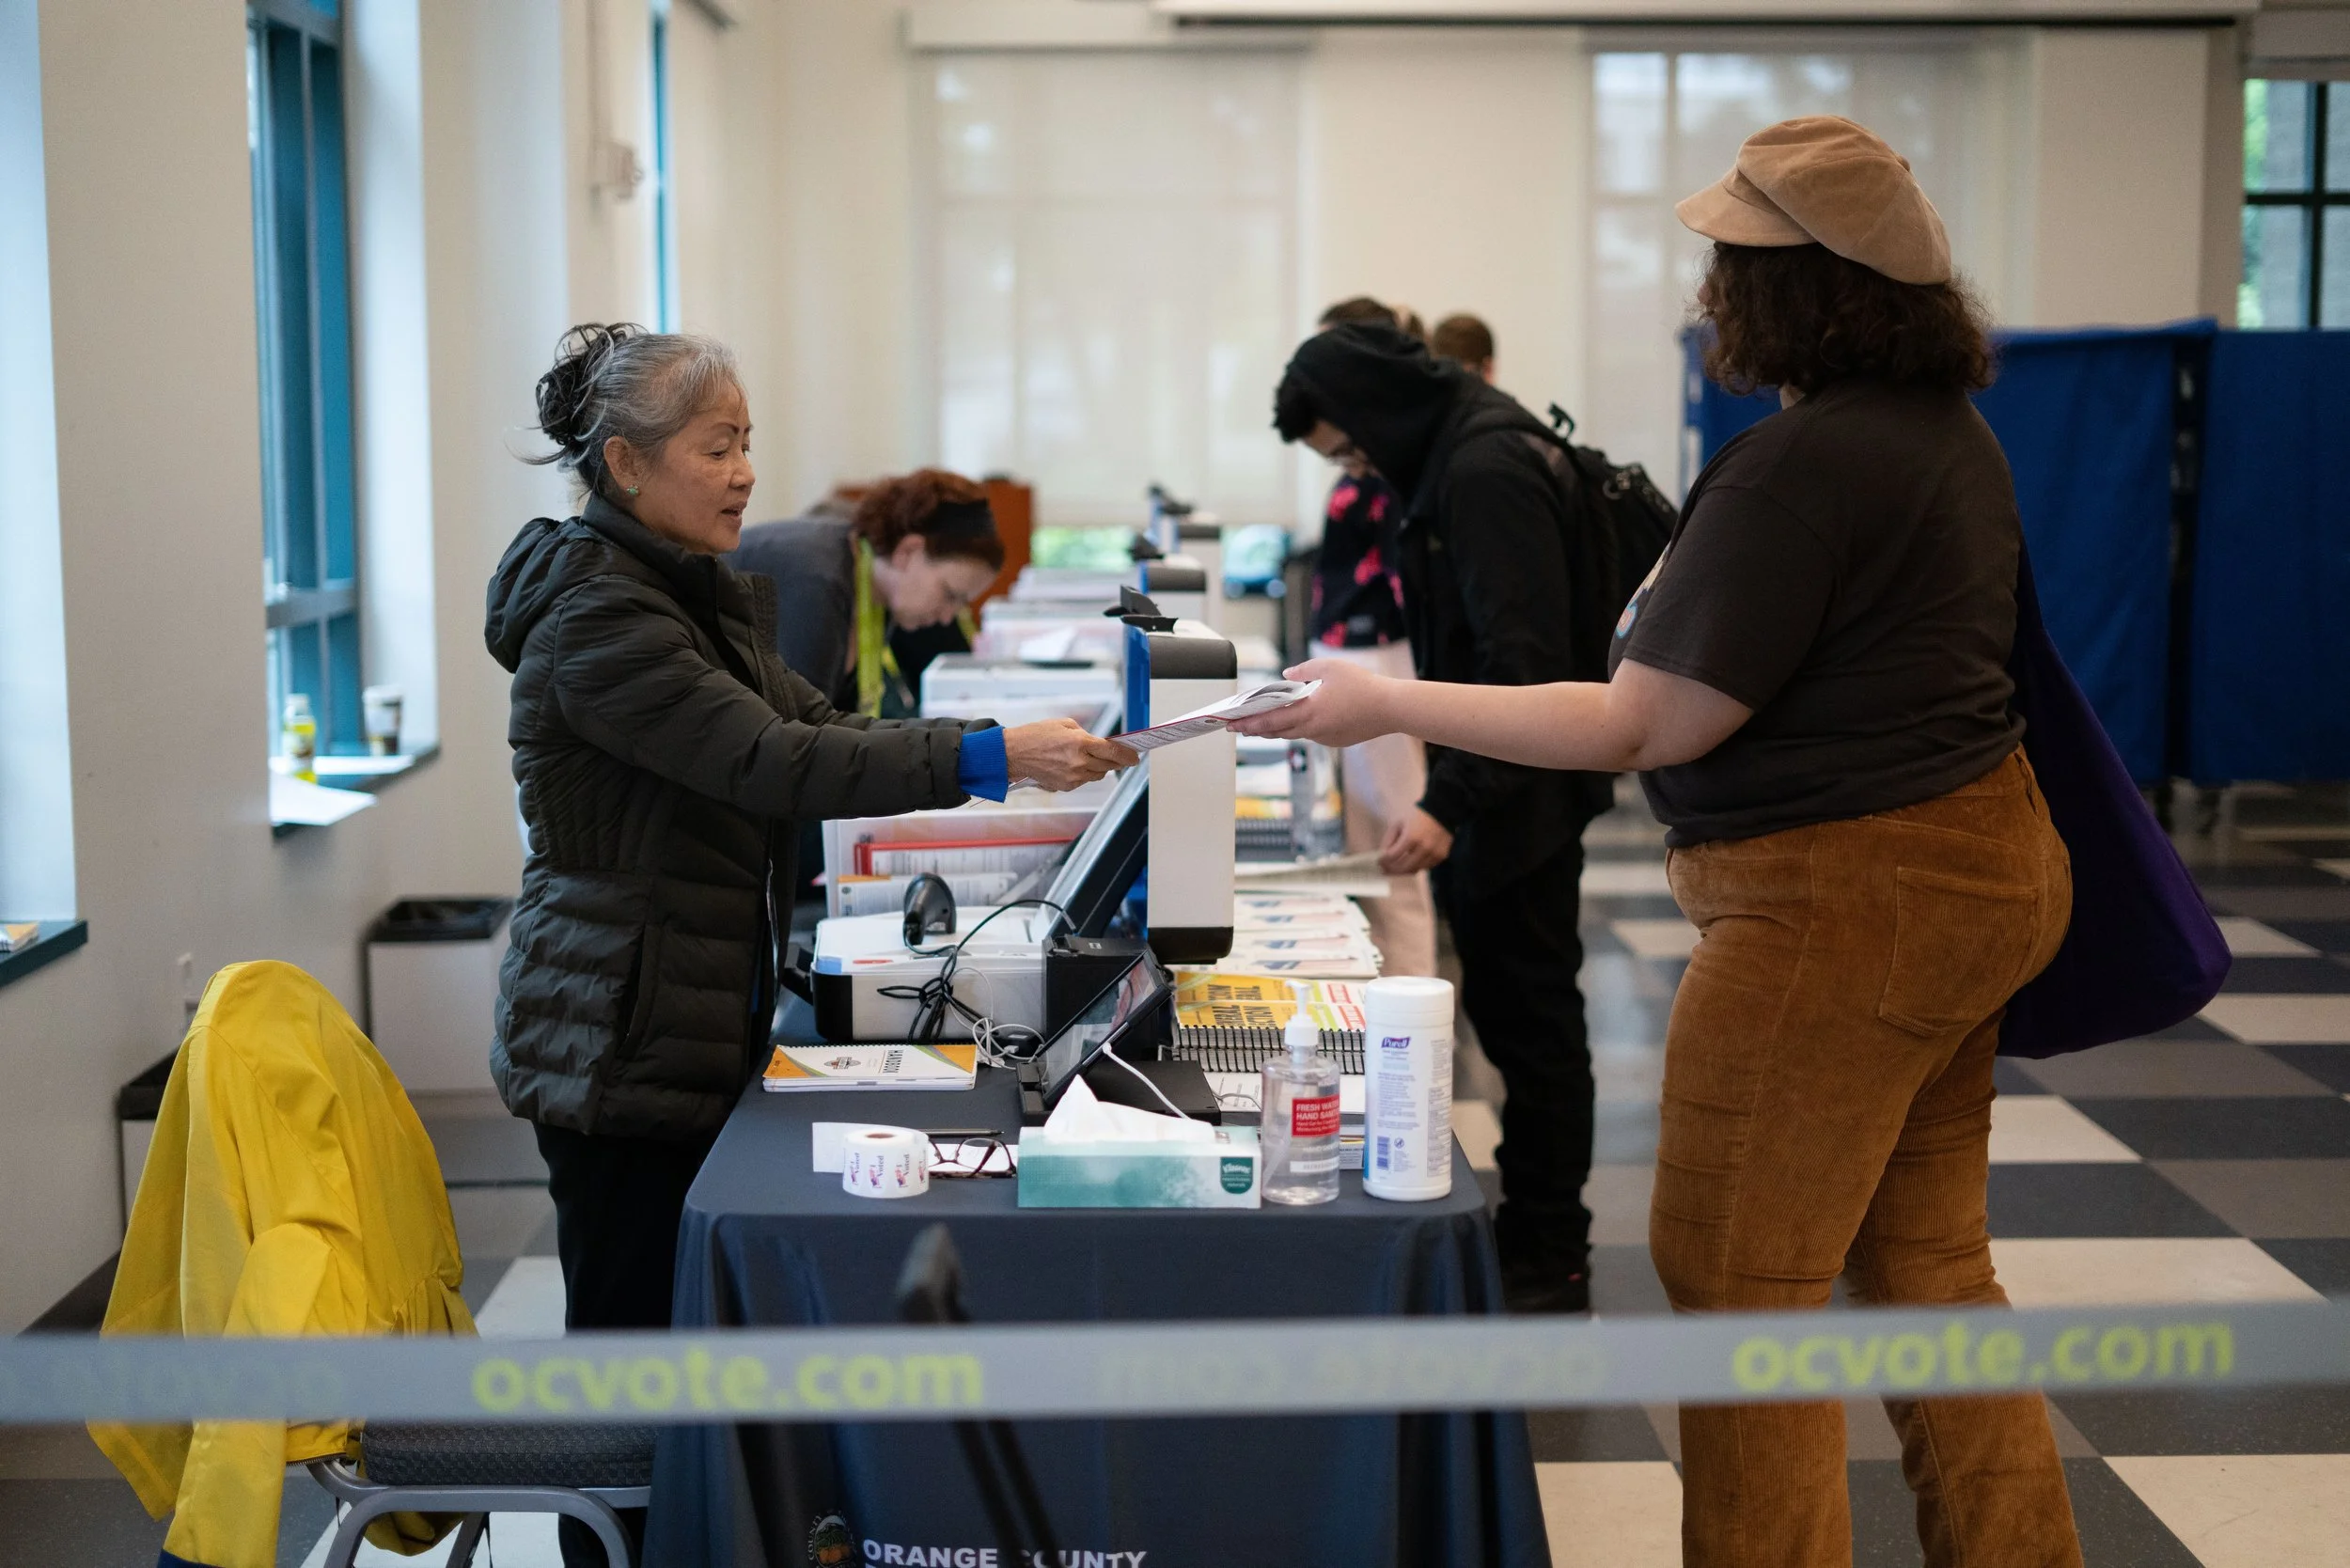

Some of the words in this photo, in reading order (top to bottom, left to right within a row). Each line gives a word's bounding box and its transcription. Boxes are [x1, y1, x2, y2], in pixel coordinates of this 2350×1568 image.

[1296, 1103, 1320, 1112] FRESH
[1296, 1112, 1319, 1121] HAND
[1732, 1322, 2234, 1392] ocvote.com
[473, 1344, 983, 1410] ocvote.com
[863, 1539, 997, 1568] ORANGE
[1017, 1550, 1147, 1568] OUNTY
